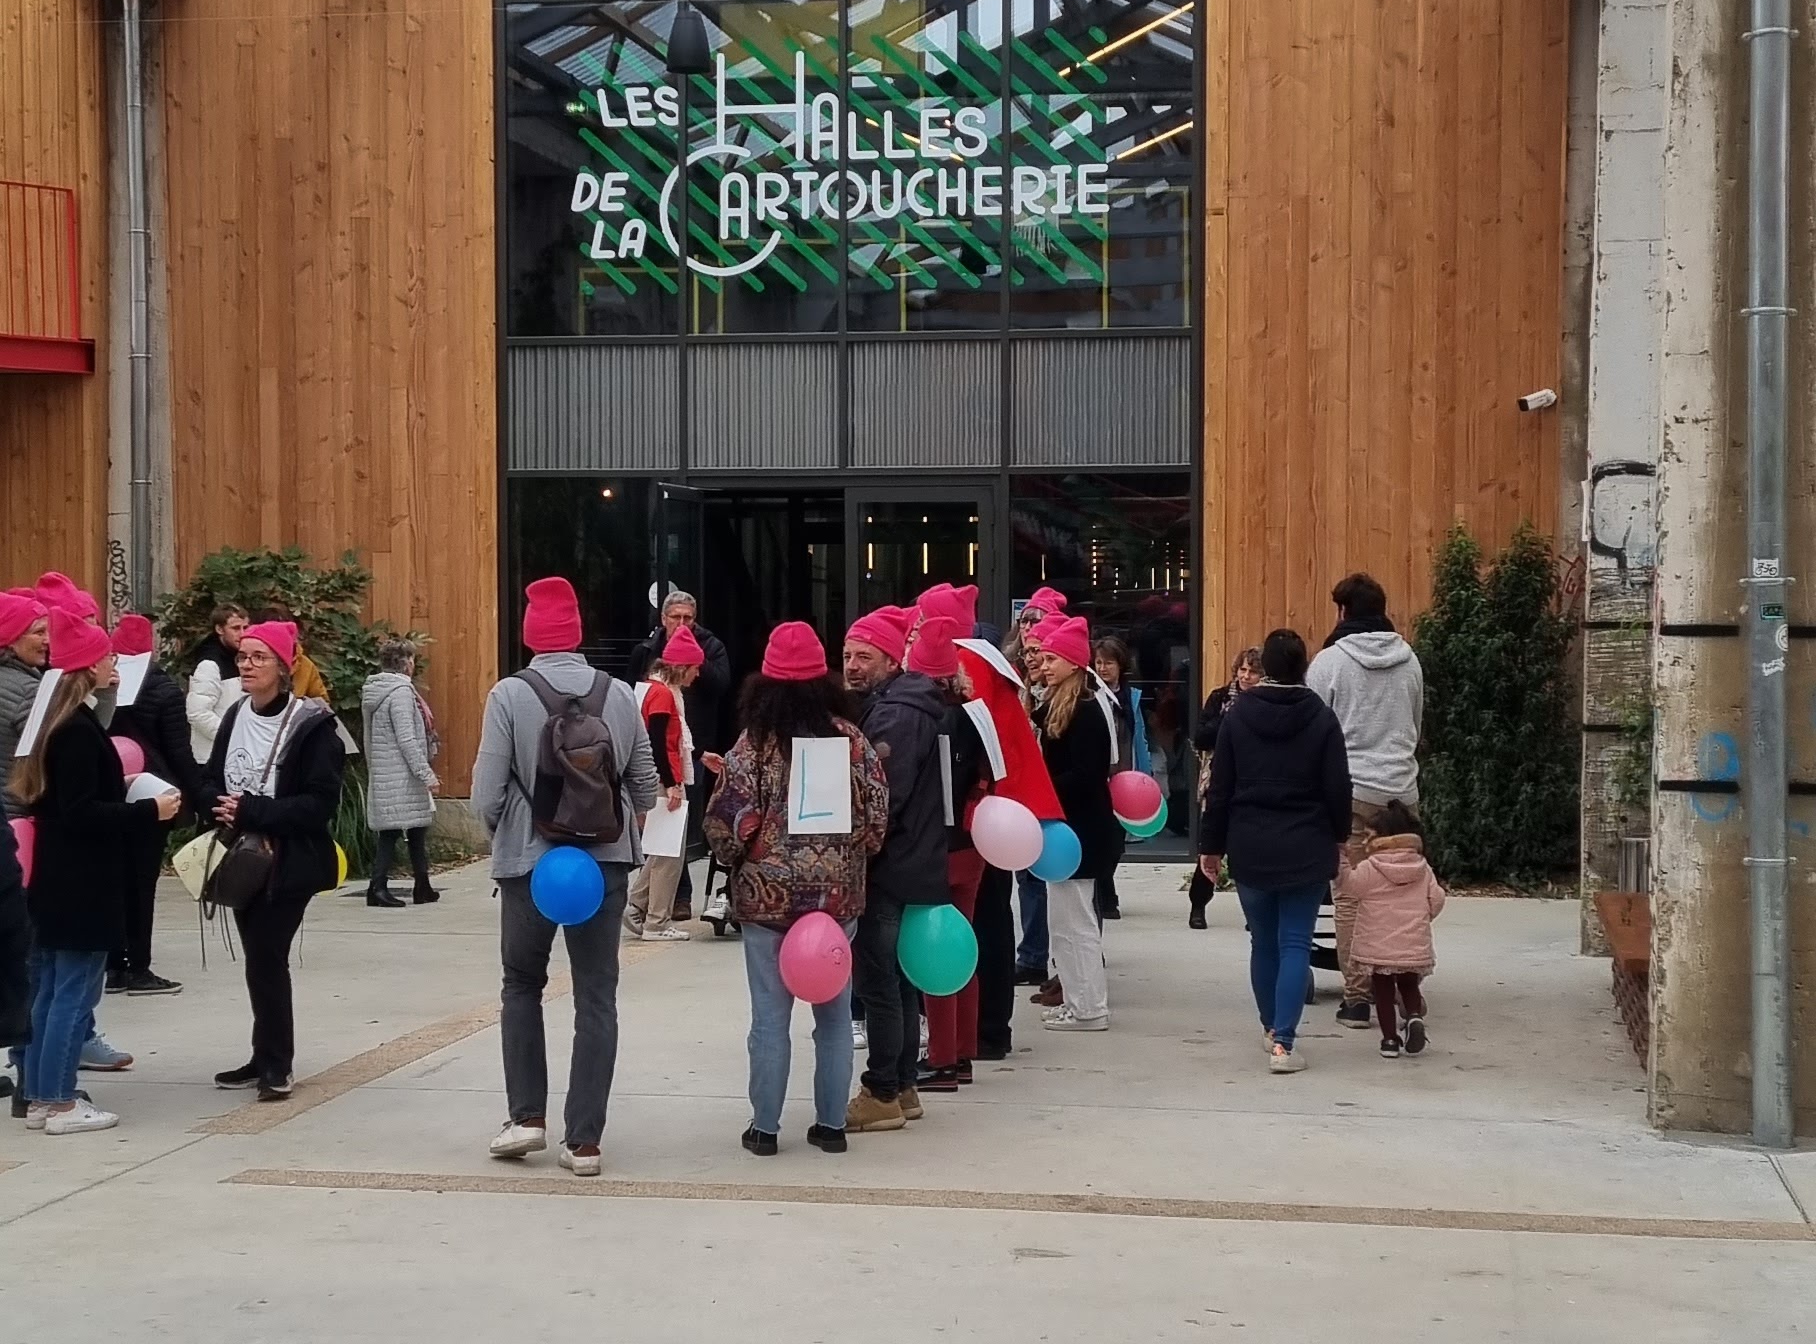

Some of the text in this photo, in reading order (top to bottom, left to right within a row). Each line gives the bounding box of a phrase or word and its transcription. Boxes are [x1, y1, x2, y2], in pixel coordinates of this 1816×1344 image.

[597, 50, 988, 162] LES HALLES
[570, 144, 1110, 277] DE LA CARTOUCHERIE
[798, 747, 834, 822] L
